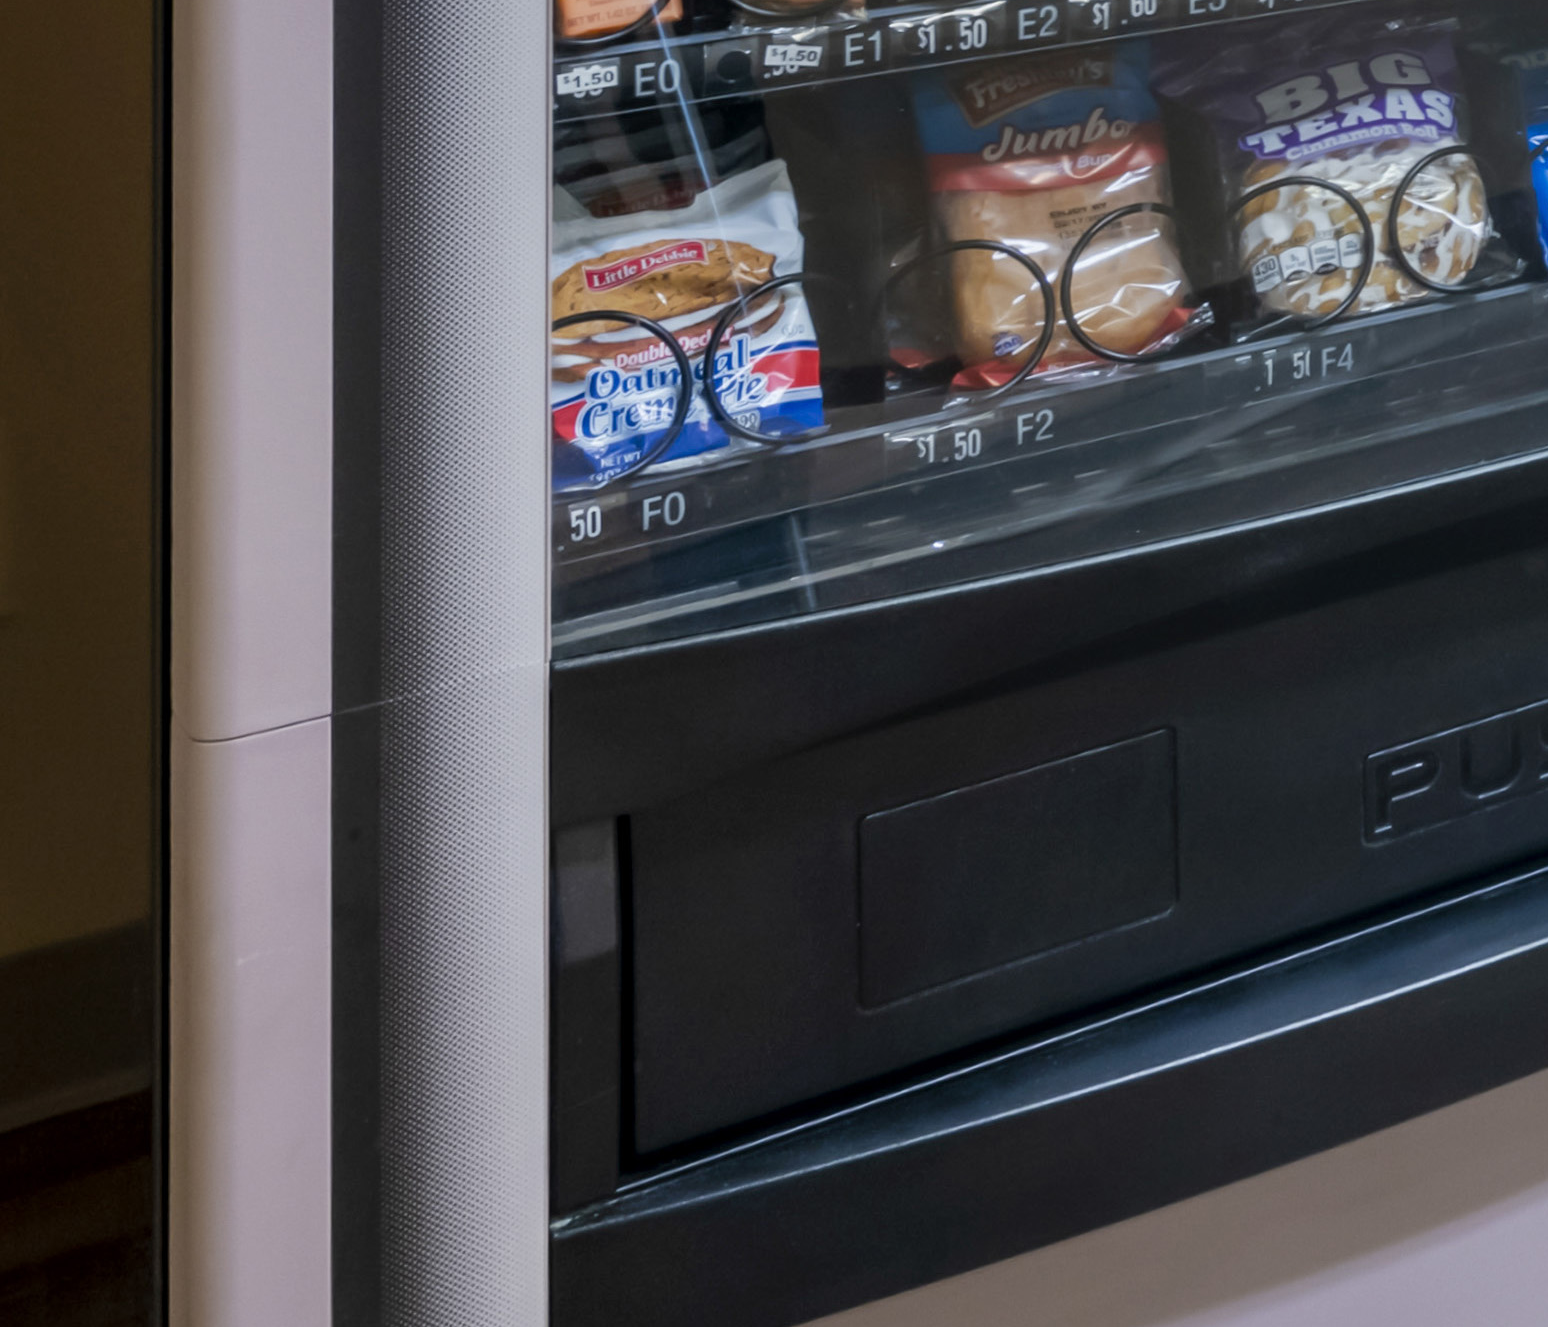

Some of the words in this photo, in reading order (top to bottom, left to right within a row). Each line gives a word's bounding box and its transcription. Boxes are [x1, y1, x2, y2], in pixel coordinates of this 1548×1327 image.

[1018, 5, 1059, 41] E2
[770, 46, 819, 64] $1.50
[845, 30, 882, 66] E1
[562, 69, 616, 89] $1.50
[1254, 51, 1432, 123] BIG
[981, 107, 1138, 162] Jumbo
[1245, 87, 1454, 155] TEXAS
[1285, 123, 1398, 161] Cinnamon
[1399, 121, 1440, 141] Roll
[592, 263, 637, 289] Little
[641, 247, 698, 270] Debbie
[1253, 258, 1276, 277] 430
[1322, 342, 1355, 378] F4
[1016, 408, 1056, 445] F2
